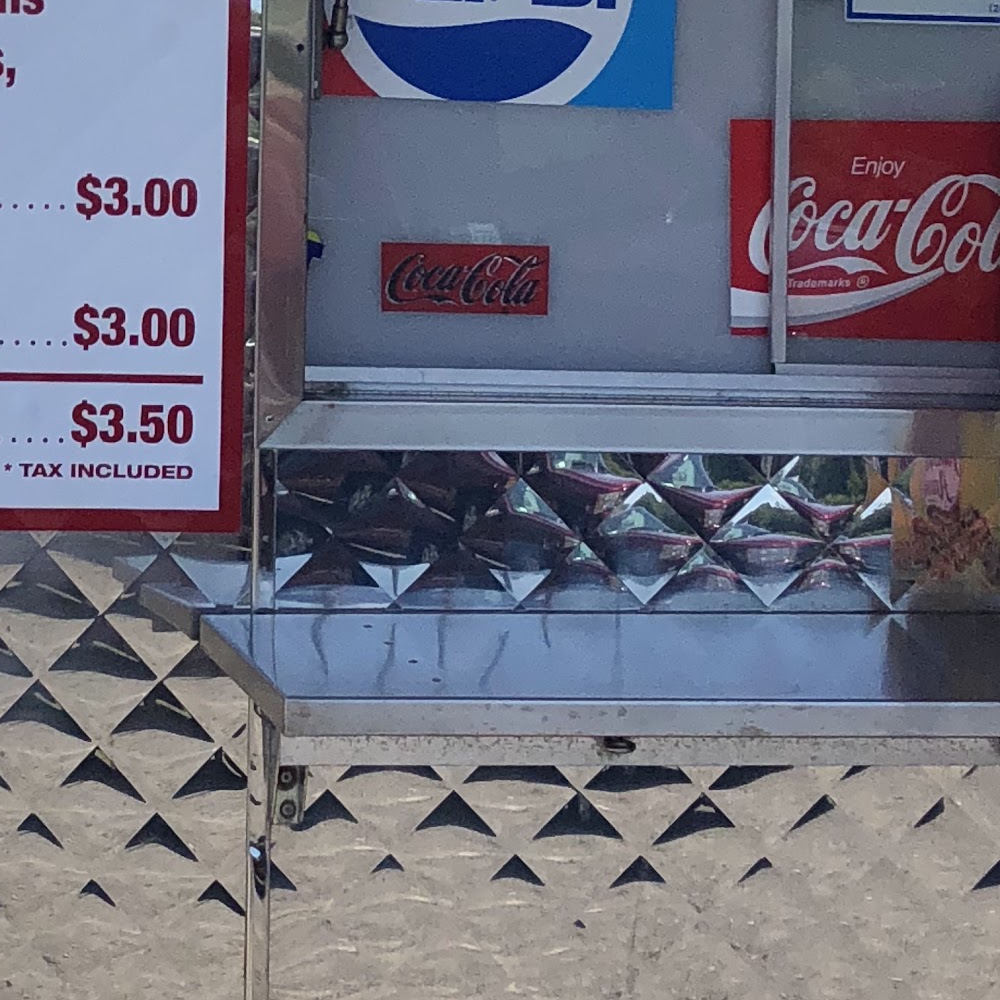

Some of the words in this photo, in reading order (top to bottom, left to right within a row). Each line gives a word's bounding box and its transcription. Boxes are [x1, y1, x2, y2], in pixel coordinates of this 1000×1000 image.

[851, 156, 905, 179] Enjoy
[75, 173, 198, 221] $3.00
[787, 276, 851, 289] Trademarks
[73, 303, 195, 351] $3.00
[70, 401, 194, 448] $3.50
[19, 463, 63, 479] TAX
[70, 464, 194, 481] INCLUDED
